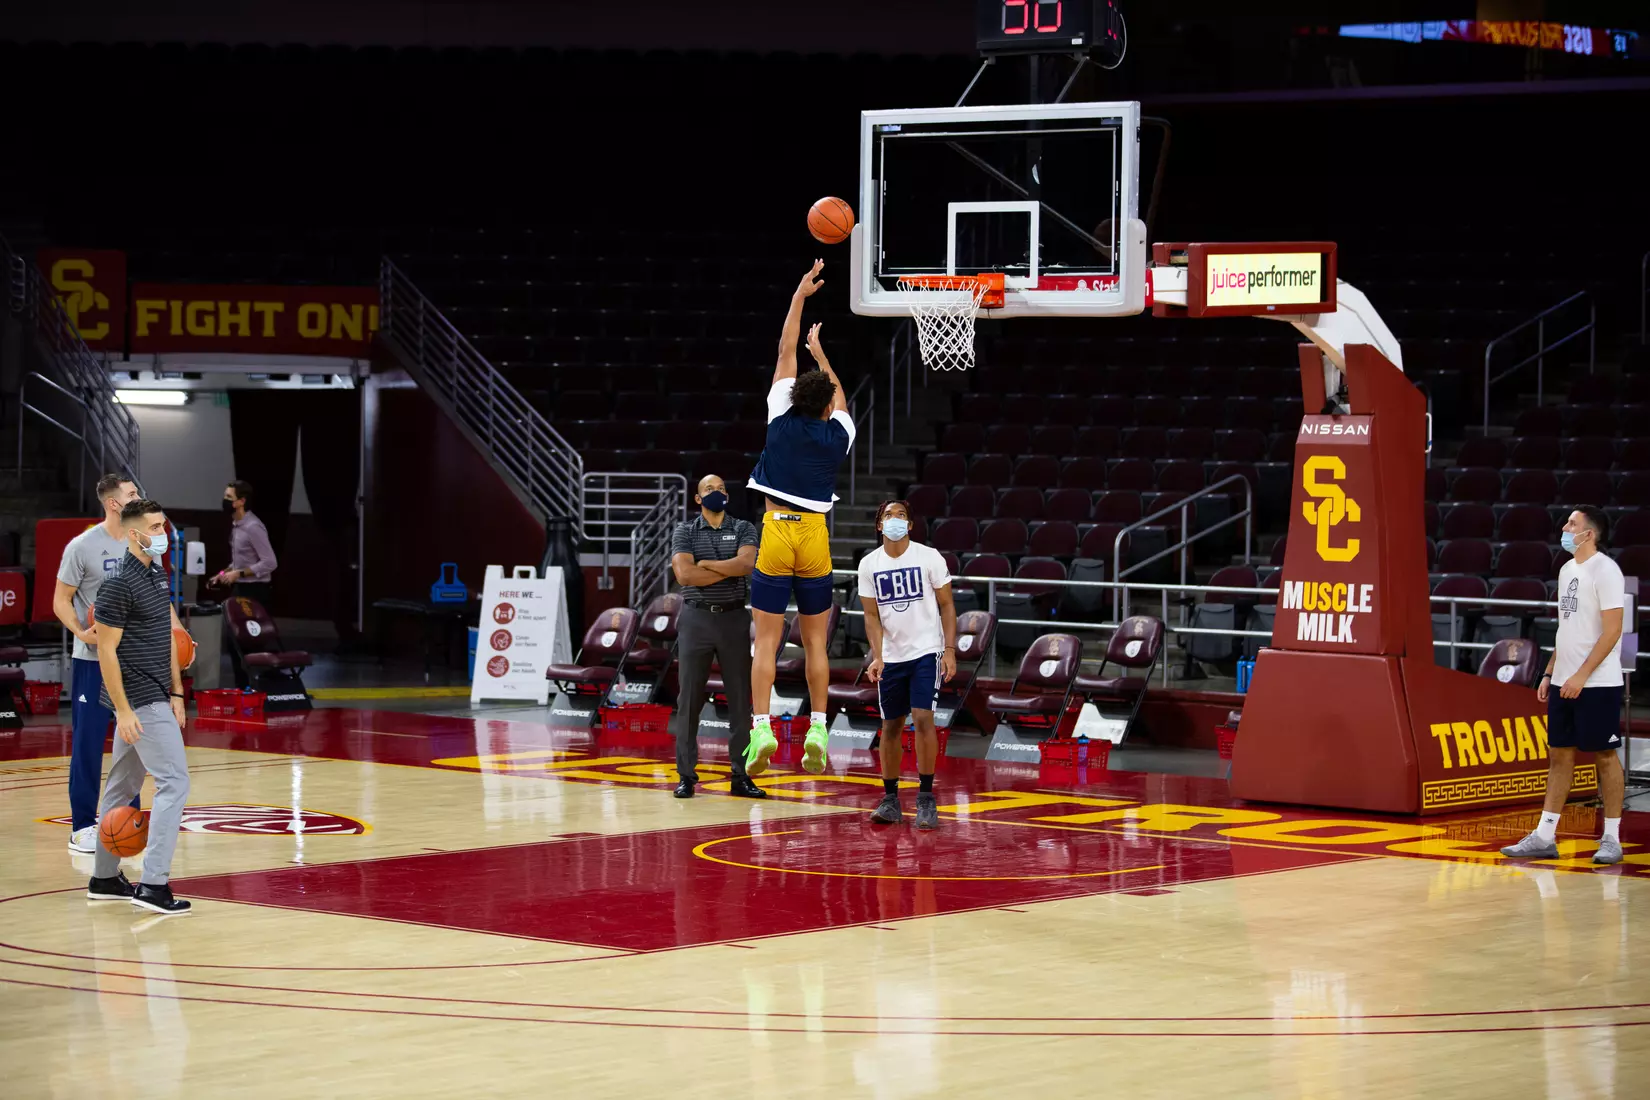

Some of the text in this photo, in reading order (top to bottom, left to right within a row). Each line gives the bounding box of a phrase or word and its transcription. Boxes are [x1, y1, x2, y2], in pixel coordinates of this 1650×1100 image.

[1210, 265, 1317, 295] juice performer
[135, 300, 379, 343] FIGHT ON!
[1301, 423, 1369, 436] NISSAN
[1302, 455, 1361, 562] SC
[499, 591, 520, 599] HERE
[522, 591, 534, 599] WE
[876, 569, 920, 601] CBU
[1283, 580, 1374, 613] MUSCLE
[829, 730, 876, 740] POWERADE
